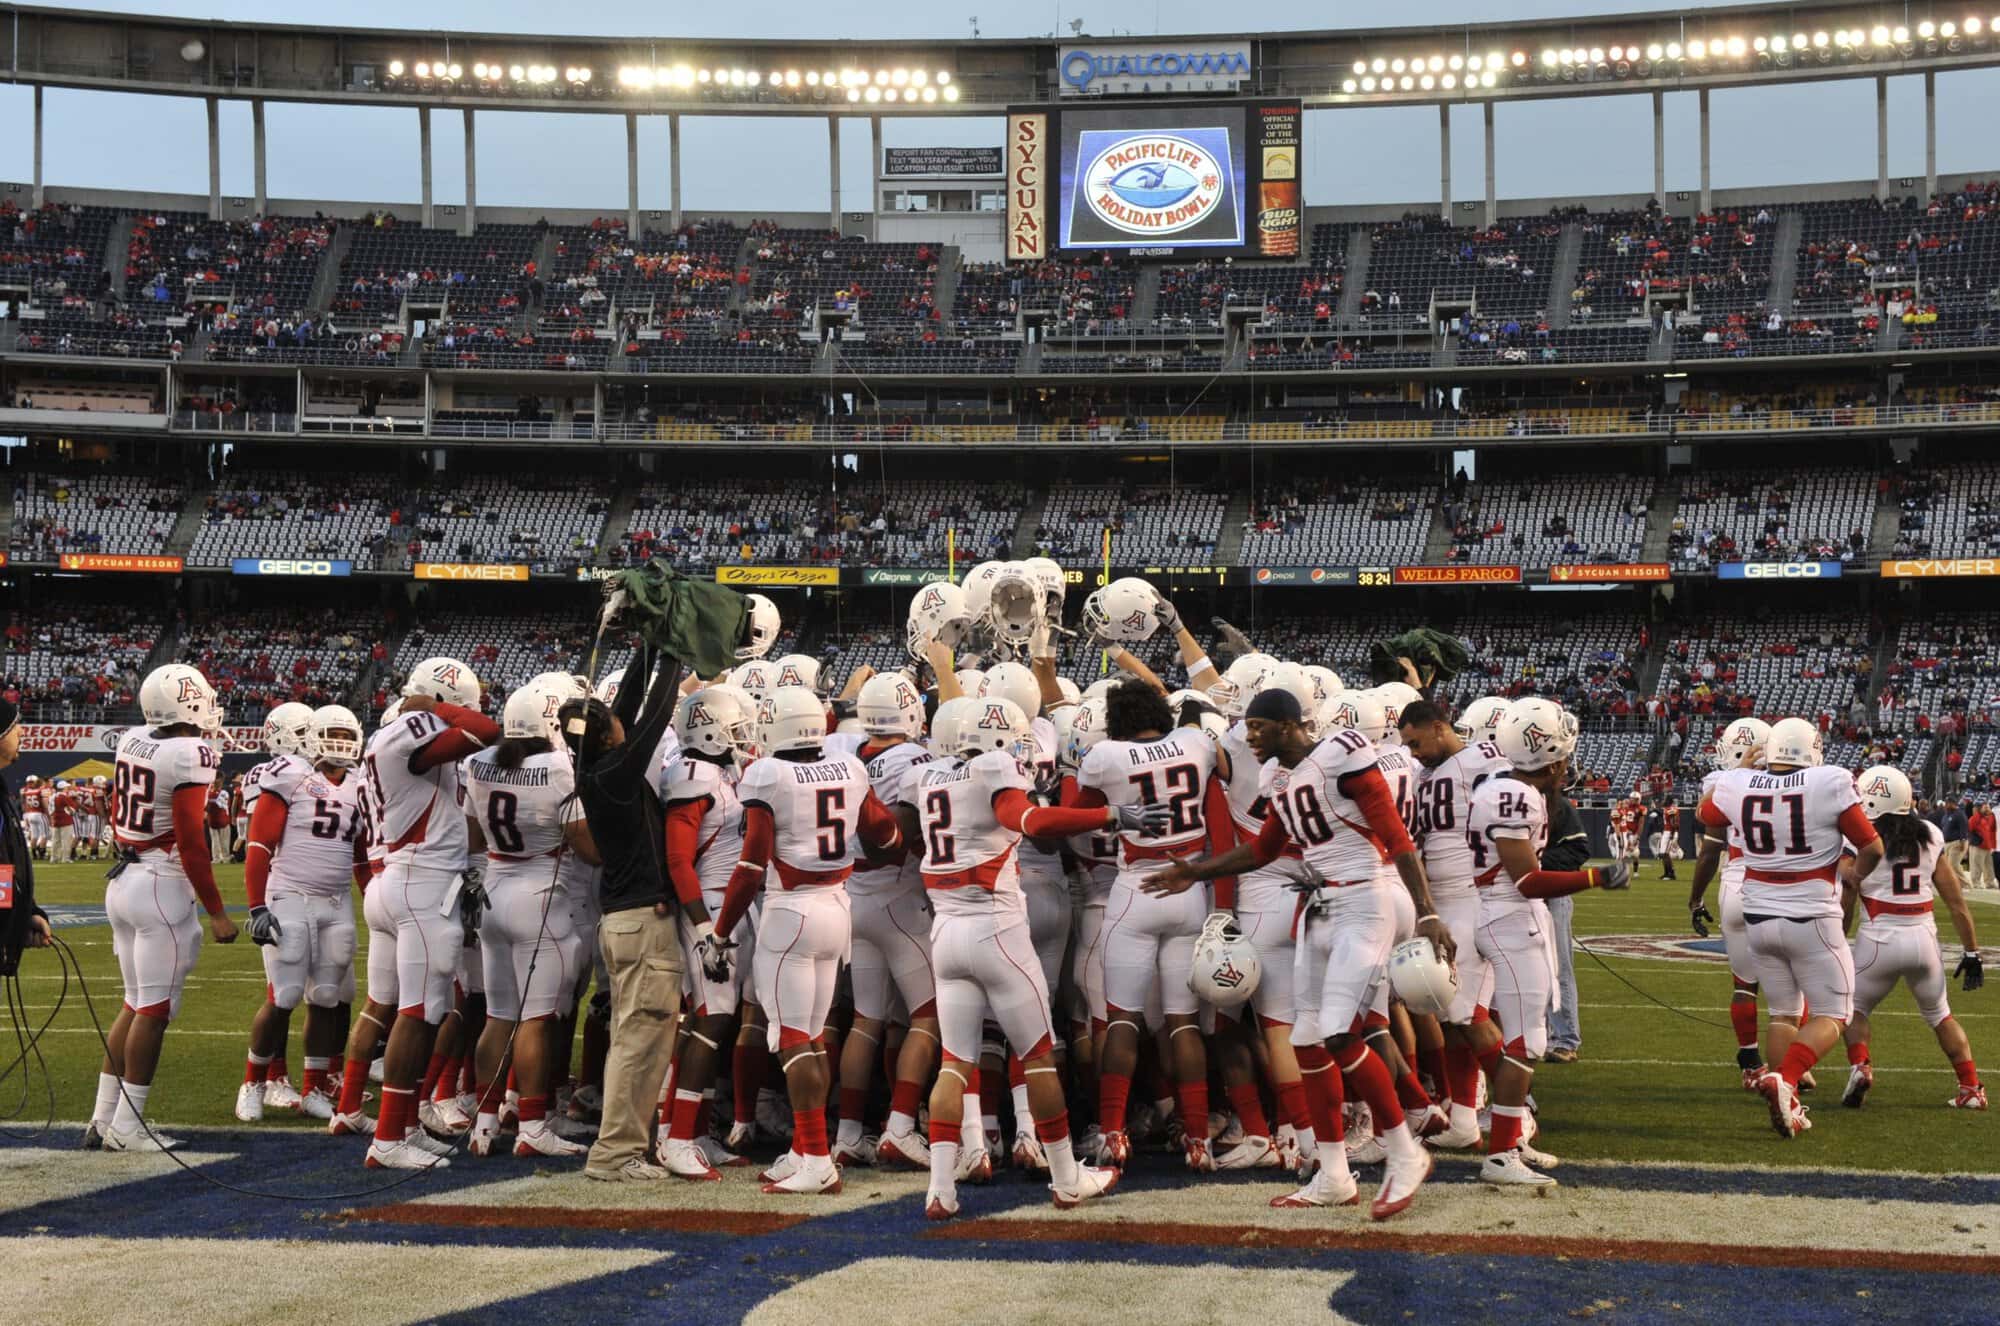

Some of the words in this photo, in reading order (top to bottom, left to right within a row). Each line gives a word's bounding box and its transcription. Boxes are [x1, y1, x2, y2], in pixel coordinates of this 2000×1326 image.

[1061, 51, 1250, 93] QUALCOMM
[1102, 79, 1237, 92] STADIUM
[1105, 143, 1167, 171] PACIFIC
[1168, 143, 1202, 169] LIFE
[1014, 120, 1038, 255] SYCUAN
[1097, 193, 1163, 227] HOLIDAY
[1164, 195, 1210, 225] BOWL
[1264, 210, 1295, 219] BUD
[1261, 217, 1298, 227] LIGHT
[89, 557, 132, 567] SYCUAN
[137, 558, 178, 568] RESORT
[258, 560, 331, 574] GEICO
[1744, 562, 1821, 578] GEICO
[1895, 560, 1994, 576] CYMER
[427, 564, 517, 580] CYMER
[778, 569, 827, 582] Pizza
[880, 572, 912, 583] Degree
[1272, 572, 1295, 580] pepsi
[1326, 572, 1349, 580] pepsi
[1358, 573, 1373, 585] 38
[1375, 573, 1390, 585] 24
[1400, 570, 1456, 580] WELLS
[1460, 568, 1514, 580] FARGO
[1577, 569, 1619, 577] SYCUAN
[1624, 567, 1665, 576] RESORT
[19, 726, 94, 738] REGAME
[406, 712, 438, 739] 87
[20, 739, 79, 750] SHOW
[1331, 730, 1366, 756] 18
[1129, 748, 1145, 765] A.
[1145, 741, 1184, 762] HALL
[684, 761, 696, 780] 7
[794, 762, 851, 784] GRIGSBY
[1748, 772, 1805, 789] BERTONI
[114, 759, 156, 835] 82
[1128, 762, 1204, 838] 12
[1499, 792, 1529, 818] 24
[488, 790, 525, 852] 8
[816, 787, 846, 860] 5
[1277, 783, 1334, 848] 18
[1741, 793, 1813, 855] 61
[927, 788, 956, 866] 2
[1892, 850, 1921, 896] 2
